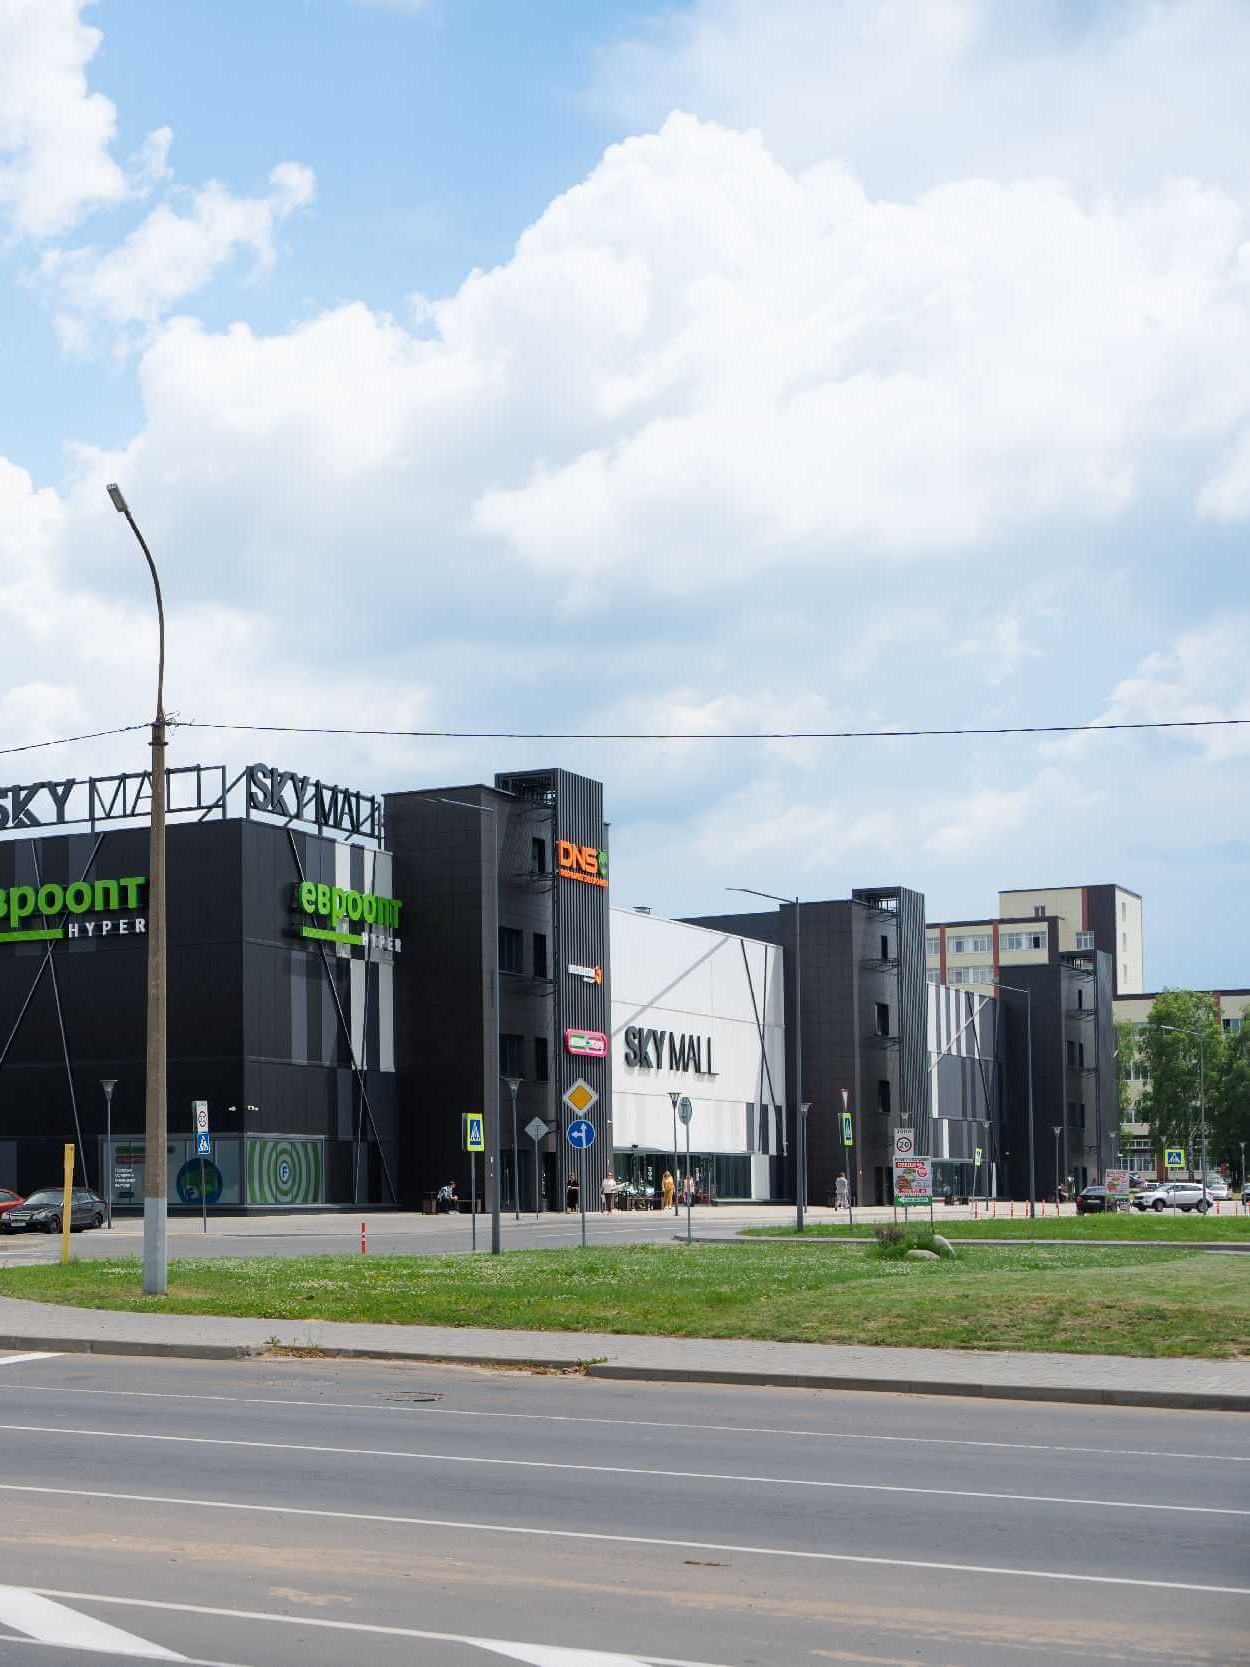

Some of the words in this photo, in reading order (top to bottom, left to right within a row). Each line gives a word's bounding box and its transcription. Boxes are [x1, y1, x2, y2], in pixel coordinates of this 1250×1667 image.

[89, 764, 225, 818] MALL
[251, 762, 311, 820] SKY
[315, 779, 383, 834] MALL
[557, 839, 598, 874] DNS
[301, 881, 403, 930] евроопт
[67, 918, 147, 938] HYPER
[362, 931, 402, 953] HYPER
[624, 1025, 667, 1069] SKY
[669, 1031, 720, 1076] MALL
[899, 1141, 910, 1149] 20
